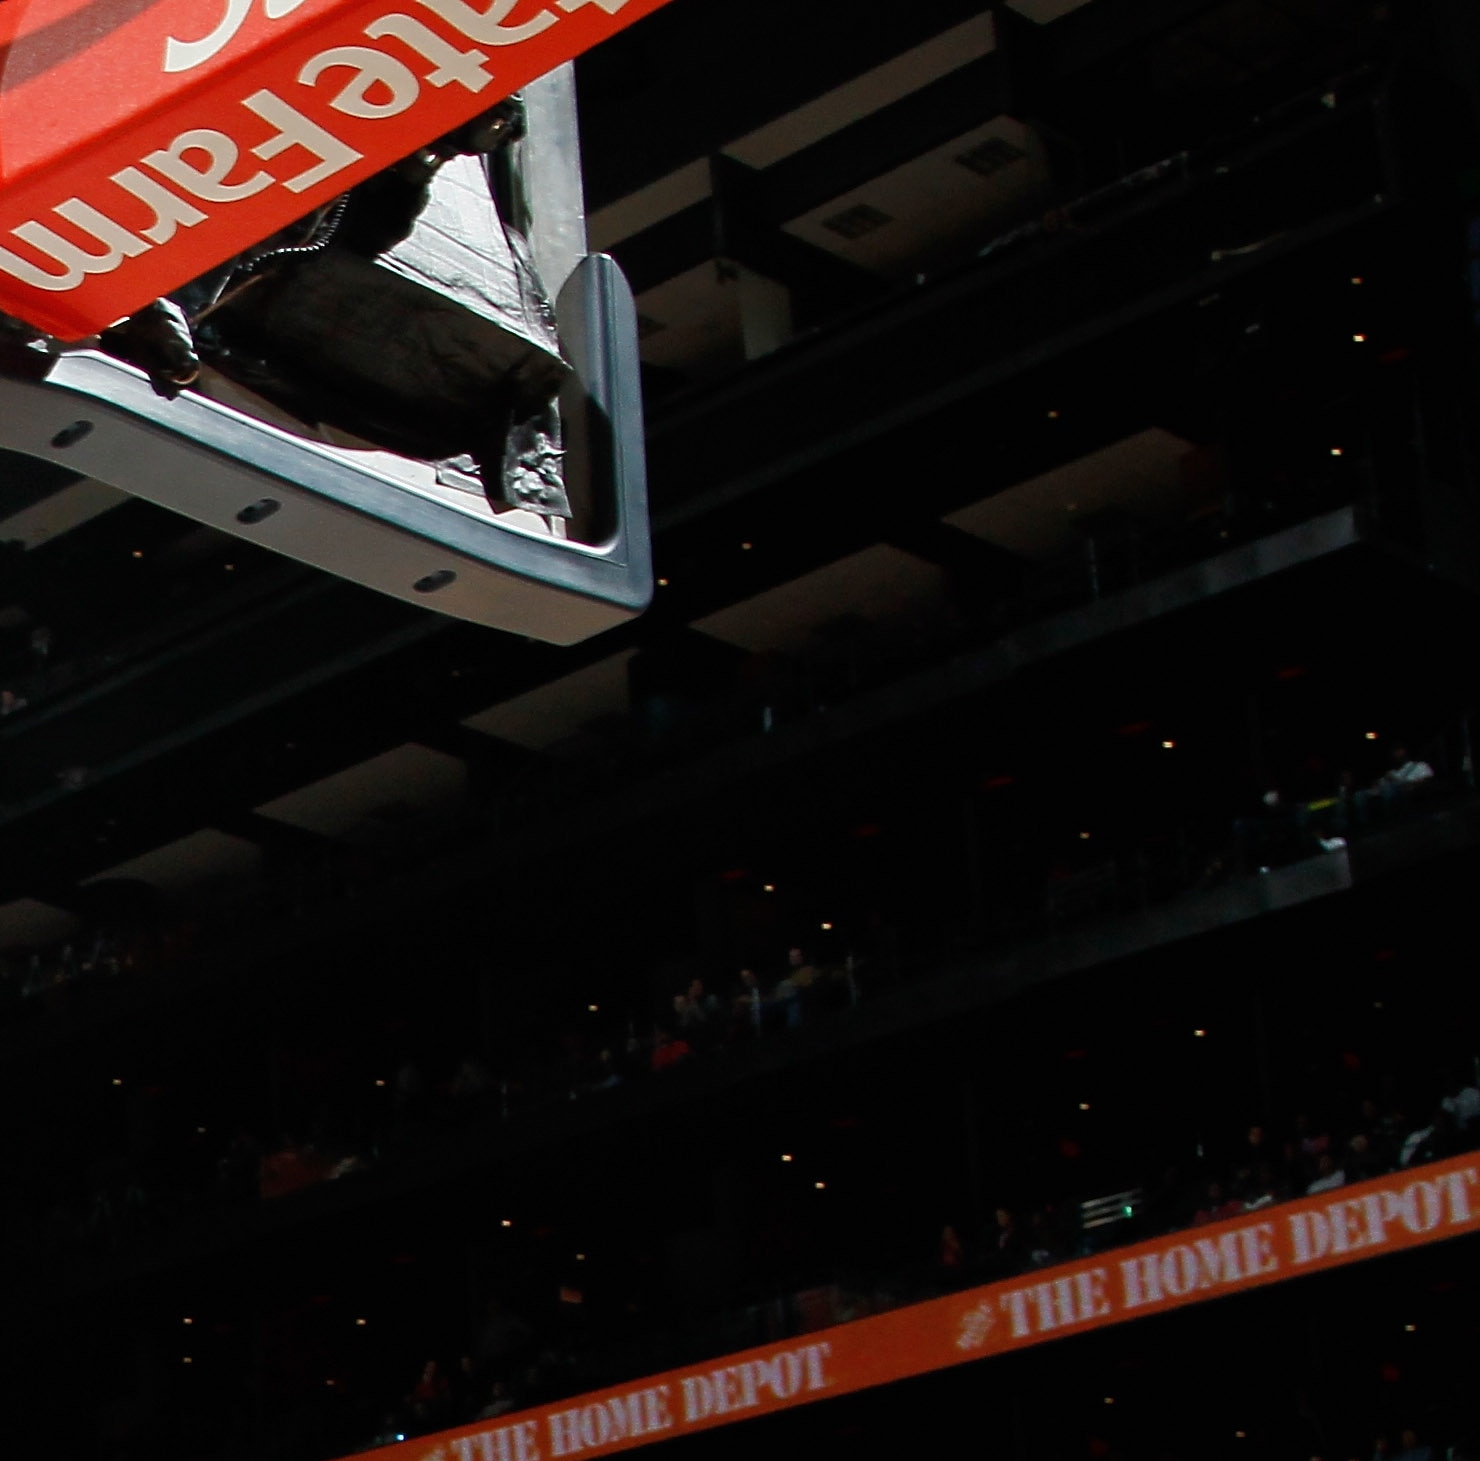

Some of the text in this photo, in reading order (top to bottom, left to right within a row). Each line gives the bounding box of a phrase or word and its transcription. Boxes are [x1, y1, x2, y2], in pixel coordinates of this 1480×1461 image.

[1000, 1167, 1480, 1340] THE HOME DEPOT
[548, 1384, 673, 1458] HOME
[681, 1341, 833, 1423] DEPOT
